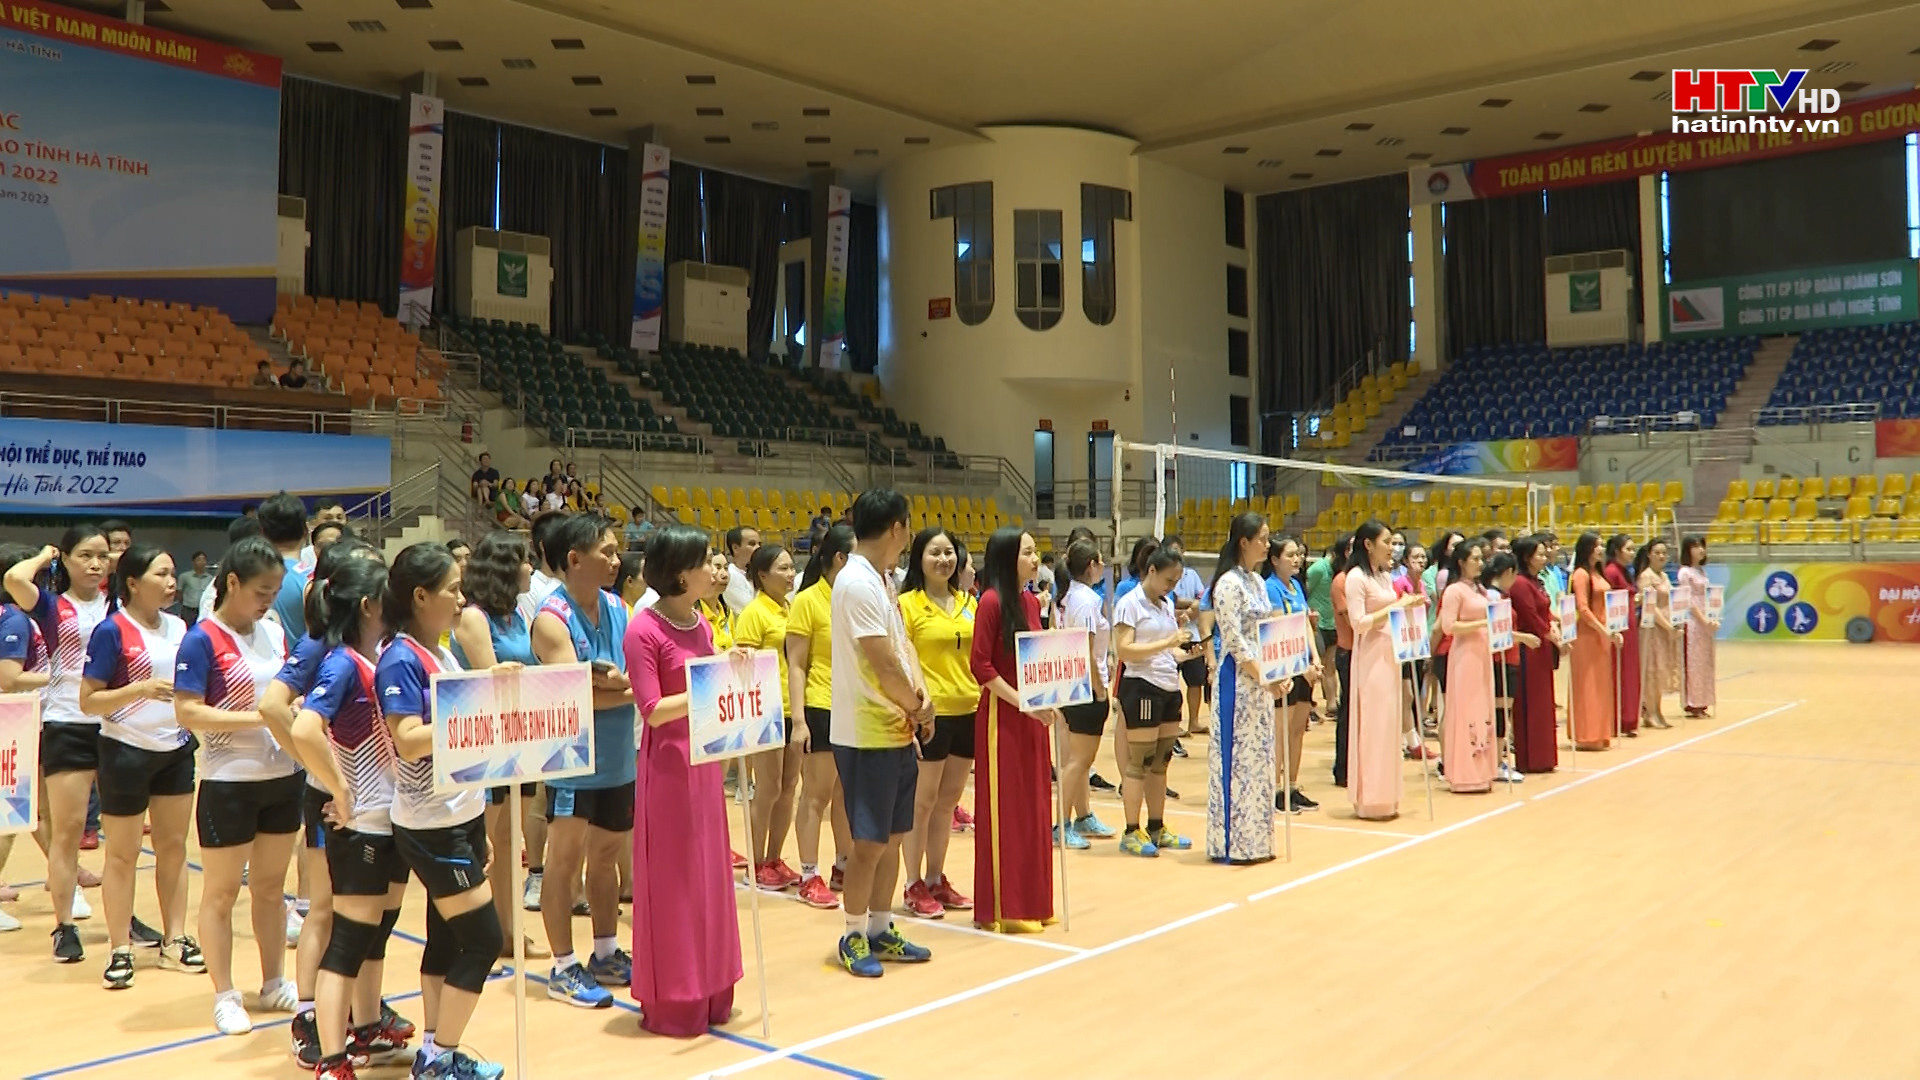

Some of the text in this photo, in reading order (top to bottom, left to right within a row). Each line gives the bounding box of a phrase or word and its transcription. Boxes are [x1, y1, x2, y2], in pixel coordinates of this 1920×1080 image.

[11, 6, 51, 31] VIỆT
[56, 16, 97, 42] NAM
[101, 27, 151, 53] MUÔN
[155, 39, 197, 63] NĂM!
[25, 141, 71, 164] TỈNH
[76, 151, 102, 169] HÀ
[1499, 163, 1545, 188] TOÀN
[1549, 157, 1587, 181] DÂN
[1592, 151, 1629, 175] RÈN
[1634, 139, 1693, 169] LUYỆN
[13, 165, 59, 185] 2022
[1738, 282, 1764, 301] CÔNG
[1766, 282, 1777, 299] TY
[1738, 306, 1764, 326] CÔNG
[1766, 306, 1777, 322] TY
[53, 448, 84, 470] DỤC,
[113, 450, 147, 468] THAO
[67, 475, 120, 495] 2022
[955, 631, 961, 650] 1
[718, 681, 763, 723] SỞ Y TẾ
[448, 705, 459, 750] SỞ
[460, 714, 473, 748] LAO
[475, 708, 495, 753] ĐỘNG
[501, 708, 528, 745] THƯƠNG
[529, 709, 546, 742] BINH
[547, 702, 556, 740] VÀ
[557, 701, 567, 738] XÃ
[568, 700, 580, 743] HỘI
